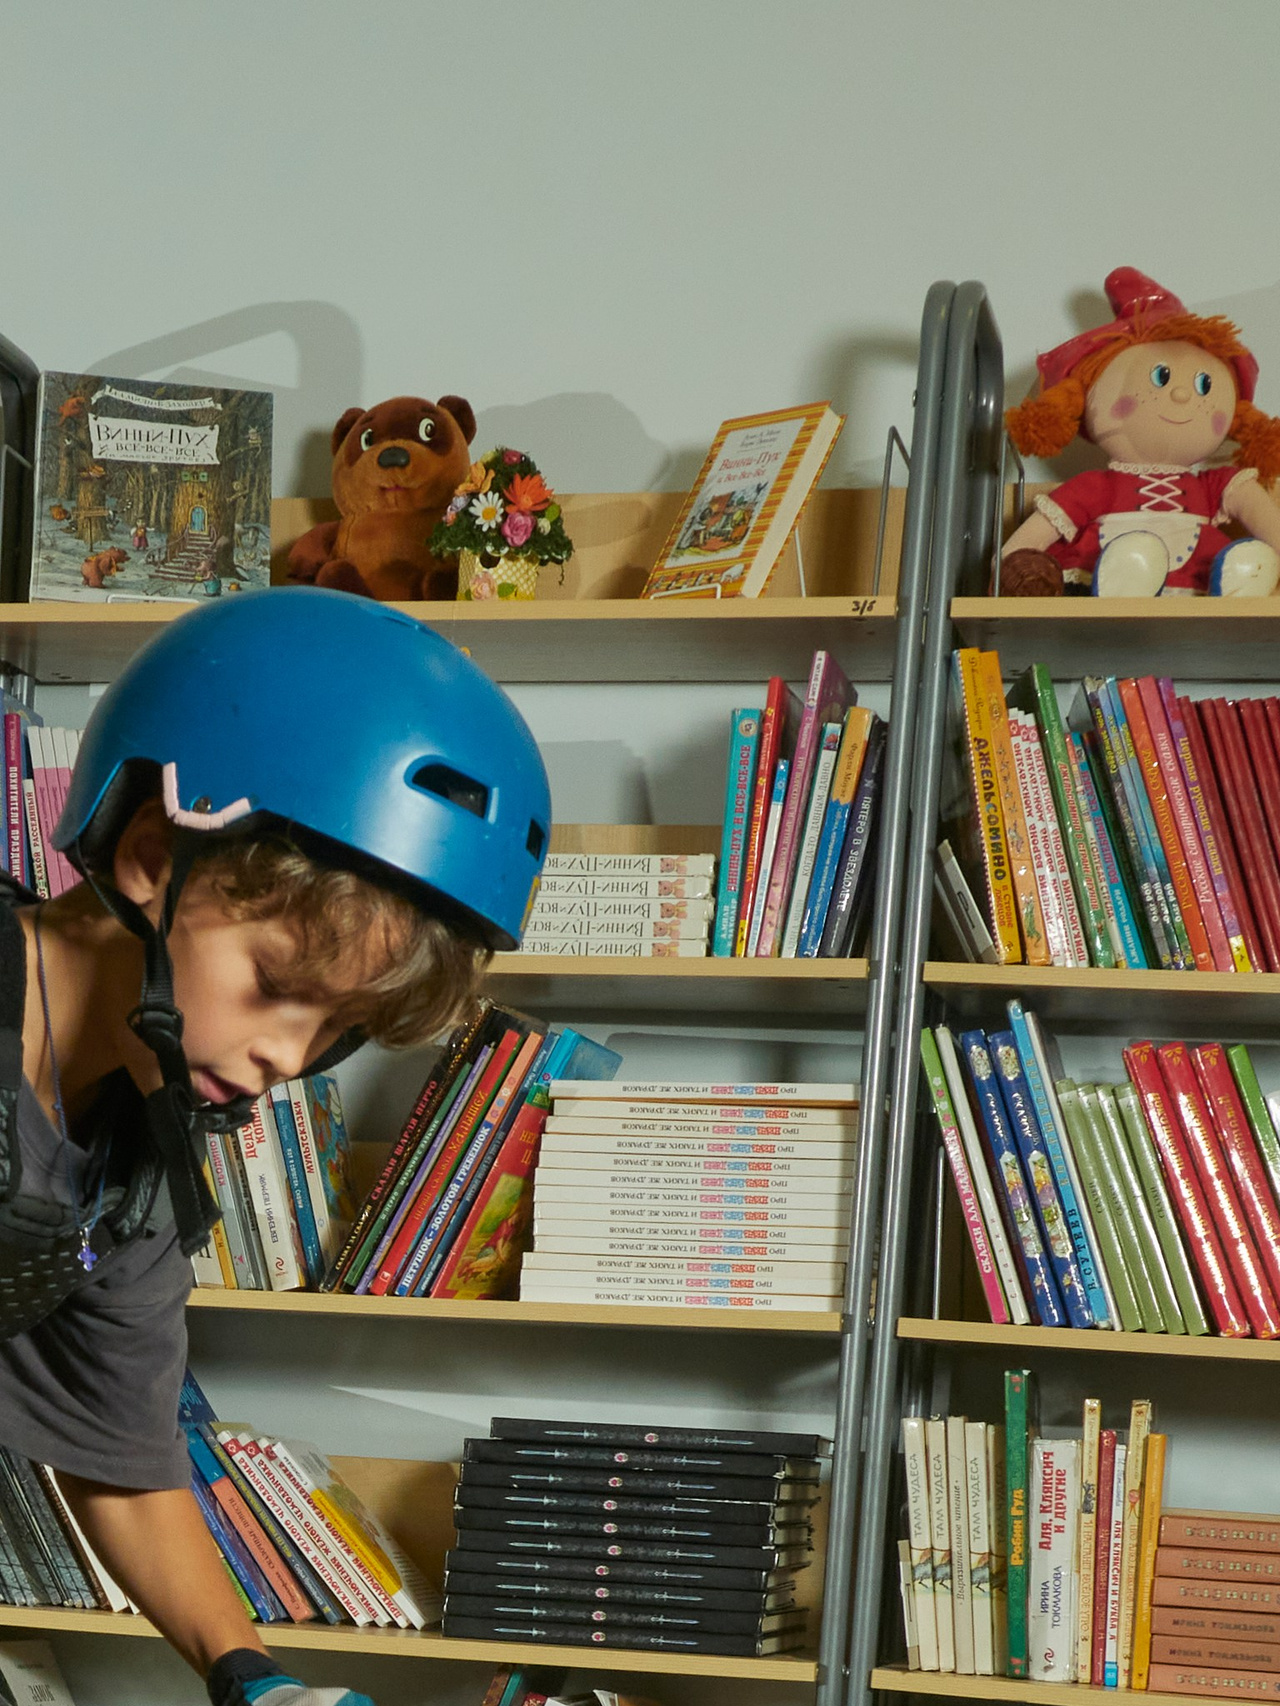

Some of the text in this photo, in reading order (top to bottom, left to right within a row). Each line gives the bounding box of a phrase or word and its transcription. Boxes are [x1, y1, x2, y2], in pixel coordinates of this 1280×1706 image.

[971, 734, 1012, 882] ДЖЕЛЬСОМИНО
[1155, 729, 1215, 904] Русские сатирические сказки
[622, 1083, 658, 1092] ДУРАКОВ
[673, 1085, 699, 1093] ТАКИХ
[289, 1099, 317, 1175] МУЛЬТСКАЗКИ
[368, 1077, 439, 1202] СКАЗКИ ШАРЛЯ ПЕРРО
[256, 1172, 279, 1244] ЕВГЕНИЙ ПЕРМЯК
[397, 1124, 492, 1288] ПЕТУШОК ЗОЛОТОЙ ГРЕБЕШОК
[962, 1195, 994, 1275] СКАЗКИ ДЛЯ
[235, 1452, 287, 1521] ЧЕМОДАНЧИКА
[906, 1452, 923, 1537] ТАМ ЧУДЕСА
[931, 1453, 945, 1538] ТАМ ЧУДЕСА
[1038, 1450, 1054, 1550] Аля, Кляксич
[1053, 1468, 1066, 1522] другие
[951, 1484, 966, 1600] Выразительное чтение
[1009, 1488, 1024, 1565] Робин Гуд
[309, 1551, 360, 1620] ПРИКЛЮЧЕНИЯ
[1040, 1580, 1050, 1613] ИРИНА
[1050, 1565, 1062, 1629] ТОКМАКОВА
